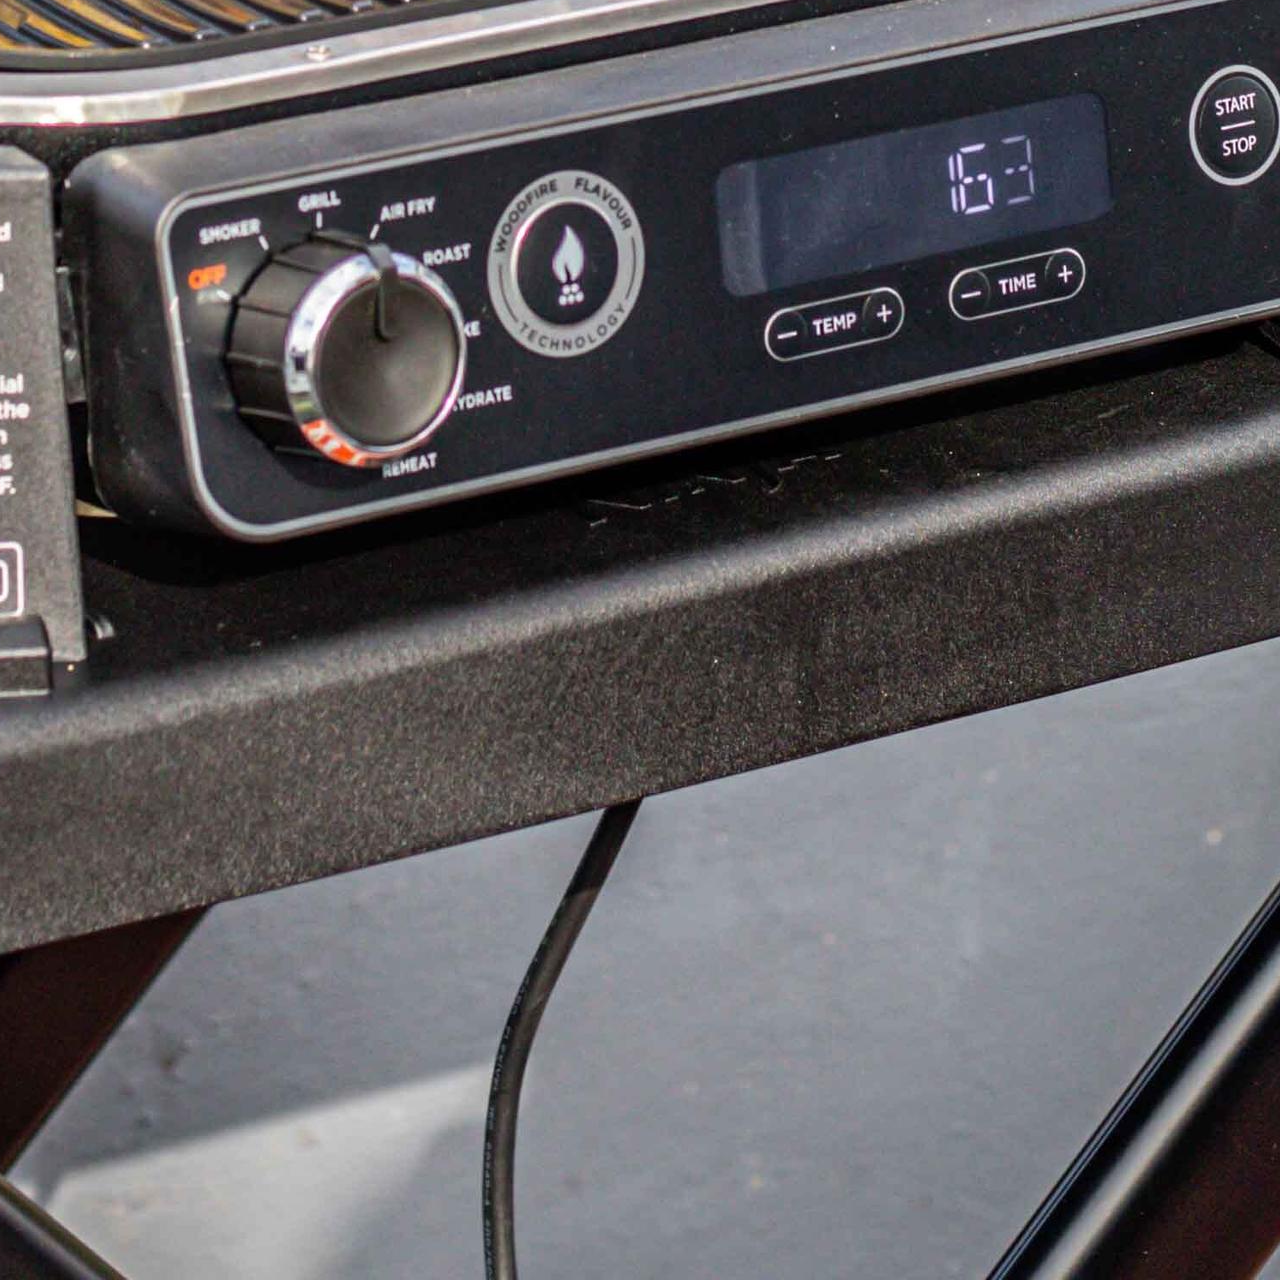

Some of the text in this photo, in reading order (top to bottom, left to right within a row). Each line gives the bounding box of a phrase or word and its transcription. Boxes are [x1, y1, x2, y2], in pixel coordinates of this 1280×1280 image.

[1214, 92, 1257, 117] START
[1221, 134, 1258, 157] STOP
[298, 190, 342, 213] GRILL
[379, 196, 437, 222] AIR FRY
[494, 176, 633, 254] WOODFIRE FLAVOUR
[199, 217, 262, 245] SMOKER
[422, 242, 472, 269] ROAST
[998, 272, 1037, 296] TIME
[463, 320, 481, 338] KE
[519, 302, 626, 351] TECHNOLOGY
[812, 310, 858, 336] TEMP
[454, 384, 513, 412] YDRATE
[381, 451, 438, 478] REHEAT
